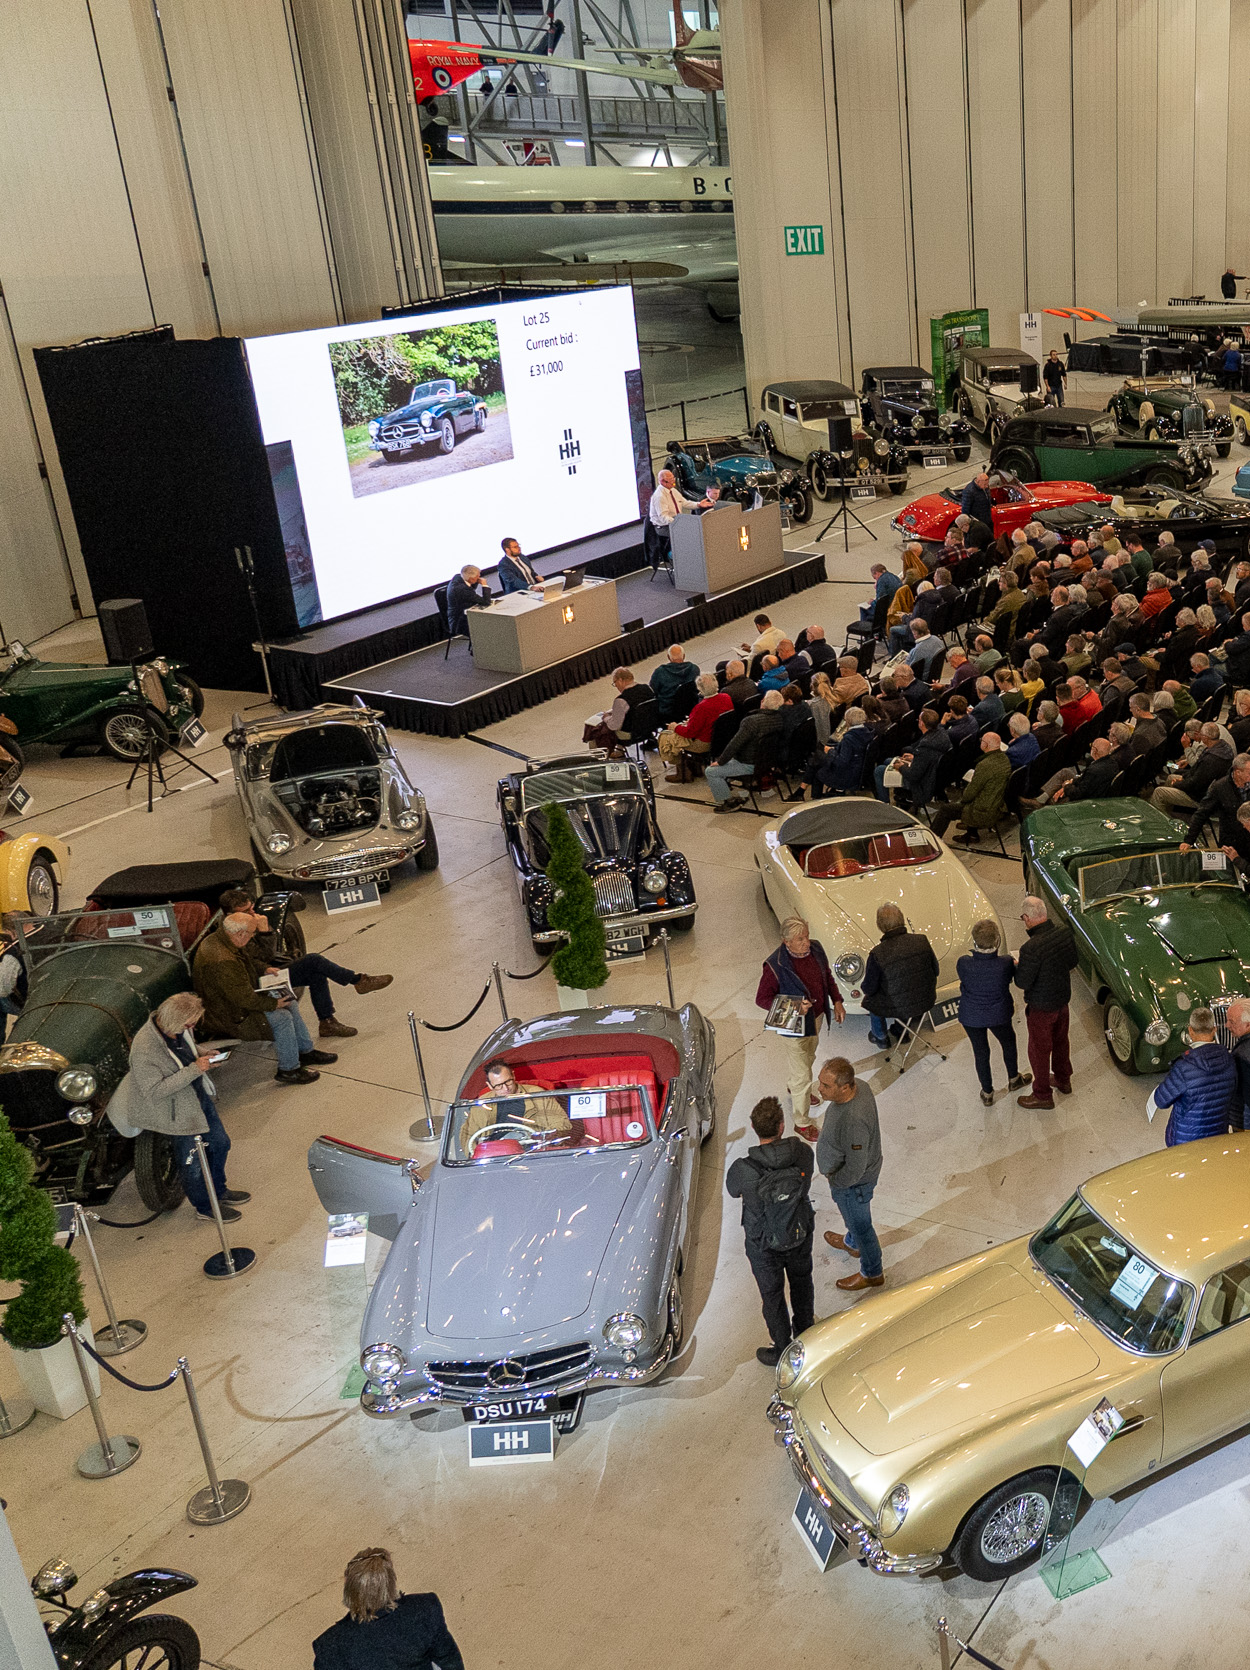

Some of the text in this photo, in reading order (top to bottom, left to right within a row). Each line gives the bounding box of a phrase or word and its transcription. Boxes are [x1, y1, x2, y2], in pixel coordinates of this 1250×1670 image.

[427, 55, 453, 66] ROYAL
[456, 56, 480, 66] NAVY
[786, 228, 821, 253] EXIT
[523, 311, 550, 326] Lot 25
[1025, 321, 1037, 329] HH
[526, 336, 558, 351] Current
[560, 332, 573, 345] bid
[530, 360, 563, 377] £31,000
[559, 440, 581, 460] HH
[190, 726, 202, 738] HH
[610, 765, 620, 773] 59
[14, 790, 26, 805] HH
[331, 872, 382, 890] 728 BPY
[339, 889, 364, 904] HH
[141, 911, 154, 919] 50
[623, 926, 645, 937] WGH
[578, 1096, 591, 1105] 60
[1133, 1261, 1145, 1274] 80
[474, 1398, 547, 1420] DSU 174
[493, 1430, 529, 1451] HH
[805, 1506, 824, 1544] HH
